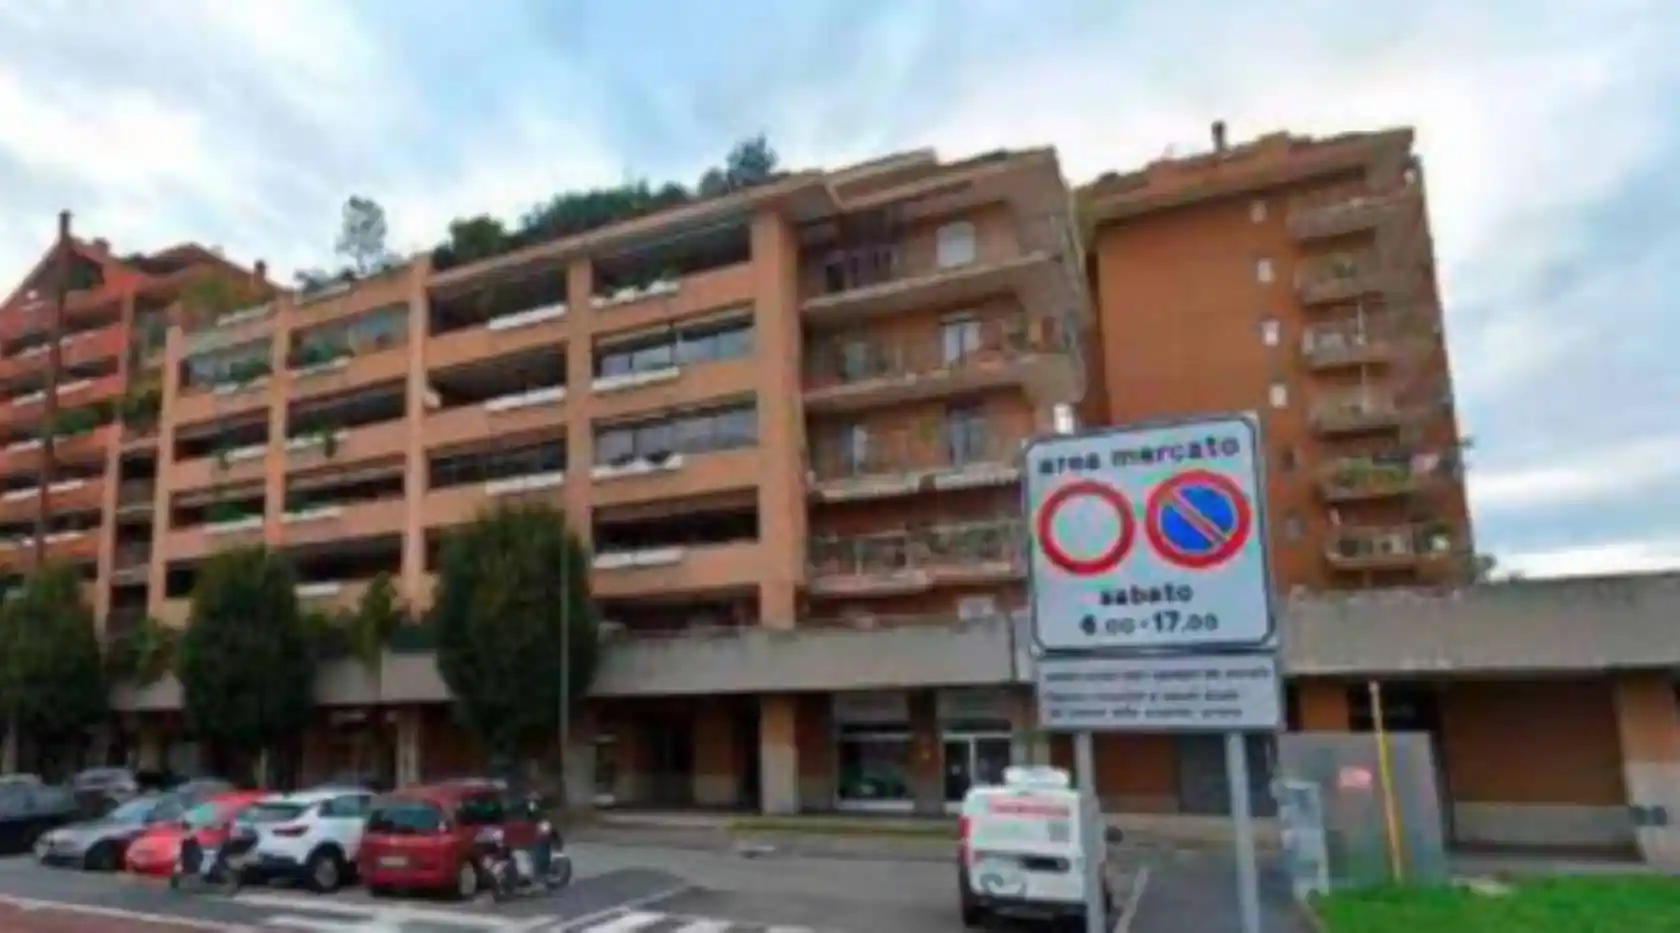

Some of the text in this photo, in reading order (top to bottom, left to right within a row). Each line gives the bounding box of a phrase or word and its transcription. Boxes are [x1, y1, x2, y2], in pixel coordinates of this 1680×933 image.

[1040, 436, 1240, 475] area mercato
[1101, 583, 1193, 605] sabato
